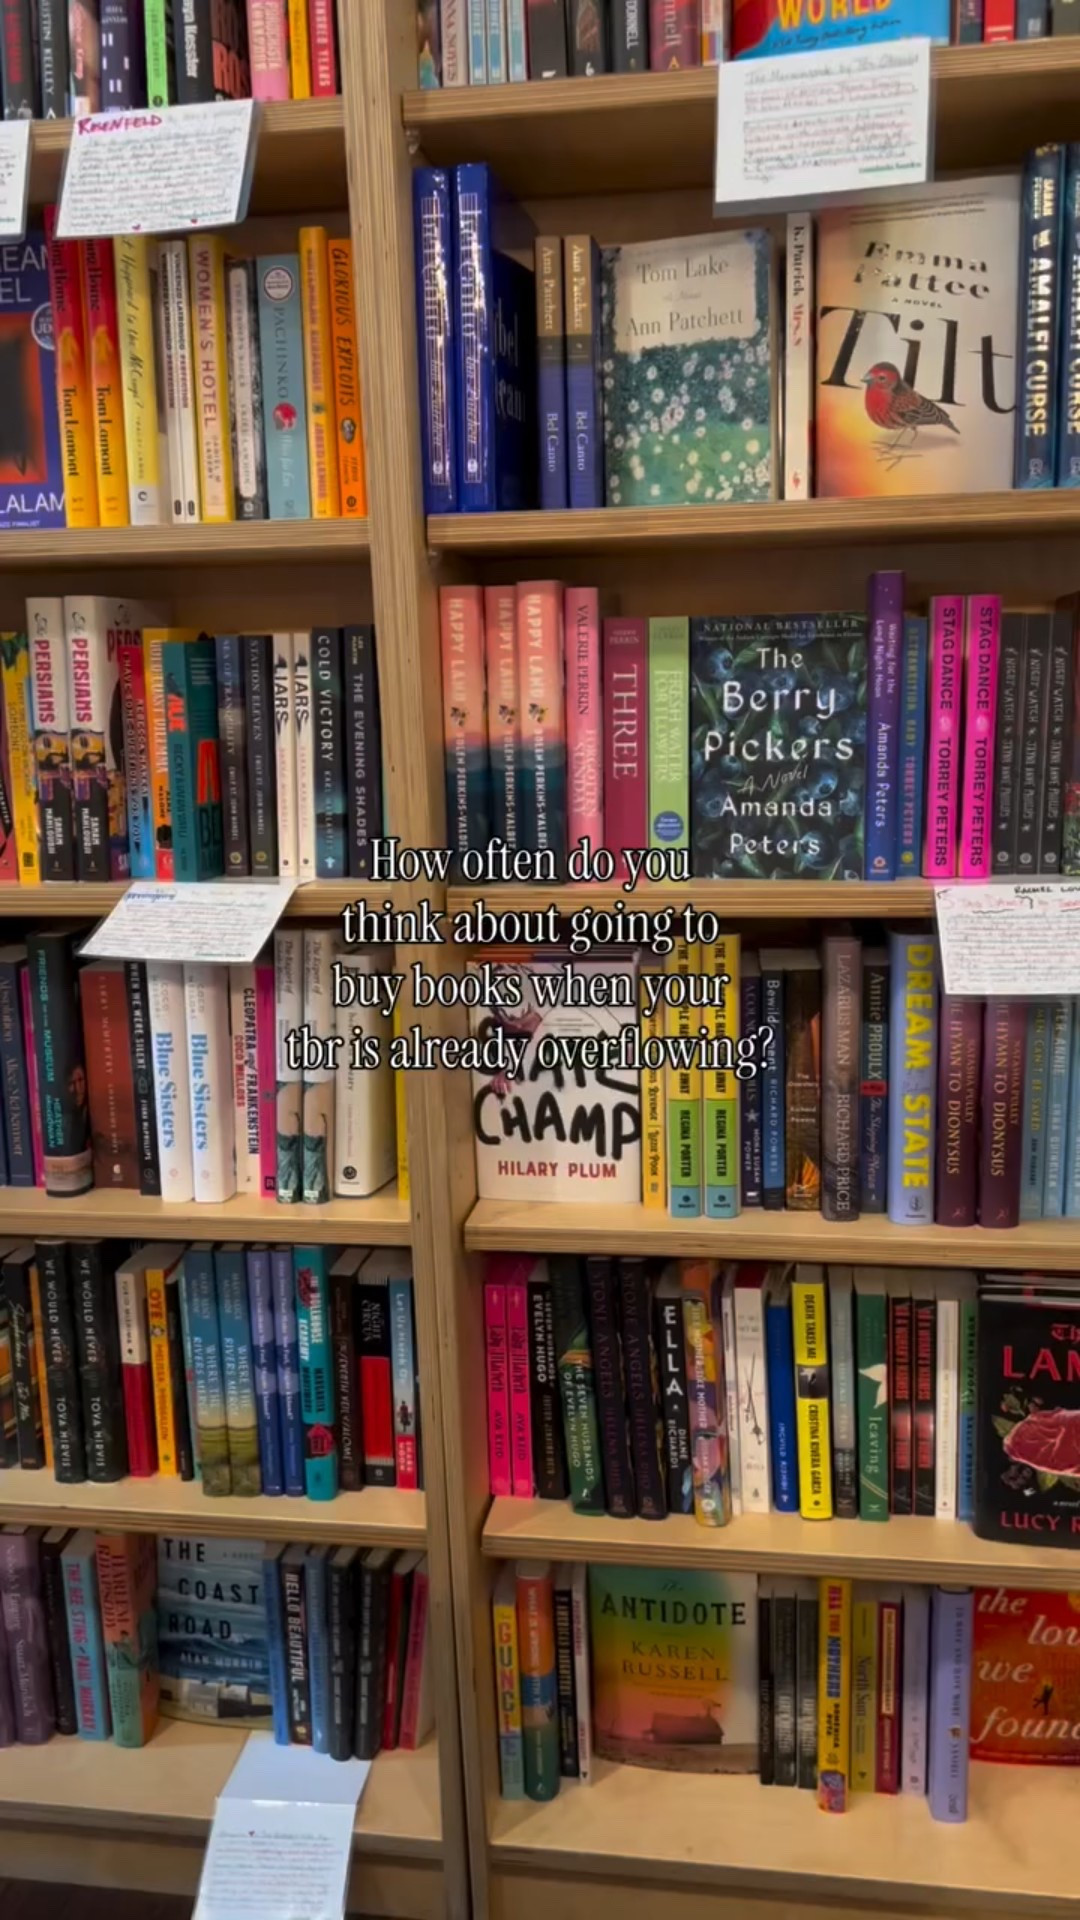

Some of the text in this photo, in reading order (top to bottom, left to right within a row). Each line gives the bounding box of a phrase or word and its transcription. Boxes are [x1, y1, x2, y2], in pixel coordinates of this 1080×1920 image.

[44, 48, 54, 95] KELLEY
[636, 256, 730, 285] Tom Lake
[794, 240, 805, 297] Patrick
[852, 264, 991, 300] Pattee
[864, 240, 988, 274] Emma
[332, 247, 353, 407] GLORIOUS EXPLOITS
[625, 306, 744, 338] Ann Patchett
[904, 298, 943, 309] NOVEL
[196, 250, 217, 429] WOMEN'S HOTEL
[273, 306, 288, 400] PACHINKO
[572, 244, 588, 471] Ann Bel Canto
[820, 305, 1018, 415] Tilt
[1025, 256, 1052, 438] AMALFI CURSE
[62, 386, 79, 477] Tom Lamont
[97, 384, 113, 476] Tom Lamont
[548, 412, 559, 473] Bel Canto
[449, 598, 466, 702] HAPPY LAND
[498, 597, 514, 702] HAPPY LAND
[525, 594, 545, 699] HAPPY LAND
[703, 618, 859, 632] NATIONAL BESTSELLER
[756, 647, 804, 669] The
[34, 639, 55, 724] PERSIANS
[72, 637, 93, 723] PERSIANS
[250, 639, 262, 741] STATION ELEVEN
[577, 604, 589, 716] VALERIE PERRIN
[274, 653, 289, 736] LIARS
[294, 652, 309, 736] LIARS
[317, 635, 335, 761] COLD VICTORY
[612, 664, 638, 779] THREE
[722, 681, 836, 719] Berry
[353, 673, 367, 848] THE EVENING SHADES
[704, 731, 854, 762] Pickers
[935, 607, 956, 867] STAG DANCE TORREY PETERS
[970, 606, 993, 867] STAG DANCE TORREY PETERS
[720, 794, 833, 817] Amanda
[737, 765, 809, 796] A Novel
[875, 722, 892, 828] Amanda Peters
[729, 833, 821, 855] Peters
[38, 950, 49, 1002] FRIENDS
[135, 1037, 146, 1070] SILENT
[233, 1035, 243, 1058] COCO
[766, 979, 780, 1071] Bewildment
[868, 972, 885, 1080] Annie PROULX
[155, 1032, 177, 1148] Blue Sisters
[191, 1034, 210, 1150] Blue Sisters
[243, 988, 260, 1154] CLEOPATRA FRANKENSTEIN
[836, 954, 851, 1212] LAZARUS MAN RICHARD PRICE
[902, 944, 934, 1189] DREAM STATE
[946, 1020, 963, 1175] HYMN TO DIONYSUS
[991, 1021, 1009, 1177] HYMN TO DIONYSUS
[474, 1085, 641, 1161] CHAMP
[680, 1109, 692, 1178] REGINA PORTER
[715, 1109, 727, 1178] REGINA PORTER
[498, 1160, 616, 1178] HILARY PLUM
[533, 1294, 547, 1383] EVELYN HUGO
[804, 1294, 815, 1320] DEATH
[805, 1322, 816, 1346] TAKES
[46, 1259, 67, 1426] WE WOULD NEVER TOVA
[81, 1259, 102, 1426] WE WOULD NEVER TOVA
[193, 1336, 205, 1376] RIVERS
[205, 1345, 217, 1382] WHERE
[224, 1337, 236, 1375] RIVERS
[663, 1305, 684, 1396] ELLA
[565, 1390, 577, 1432] EVELYN
[576, 1383, 594, 1482] SEVEN HUSBANDS
[808, 1403, 821, 1469] CRISTINA RIVERA
[570, 1434, 580, 1468] HUGO
[865, 1417, 883, 1475] leaving
[163, 1538, 206, 1563] THE
[1001, 1511, 1061, 1531] LUCY
[178, 1577, 260, 1604] COAST
[602, 1592, 747, 1626] ANTIDOTE
[977, 1589, 1028, 1615] the
[72, 1608, 87, 1646] STING
[168, 1614, 233, 1640] ROAD
[180, 1651, 208, 1666] ALAN
[285, 1572, 305, 1682] HELLO BEAUTIFUL
[631, 1640, 716, 1661] KAREN
[622, 1659, 729, 1682] RUSSELL
[855, 1655, 872, 1690] North
[978, 1660, 1034, 1683] we
[833, 1703, 841, 1748] DOMENICA
